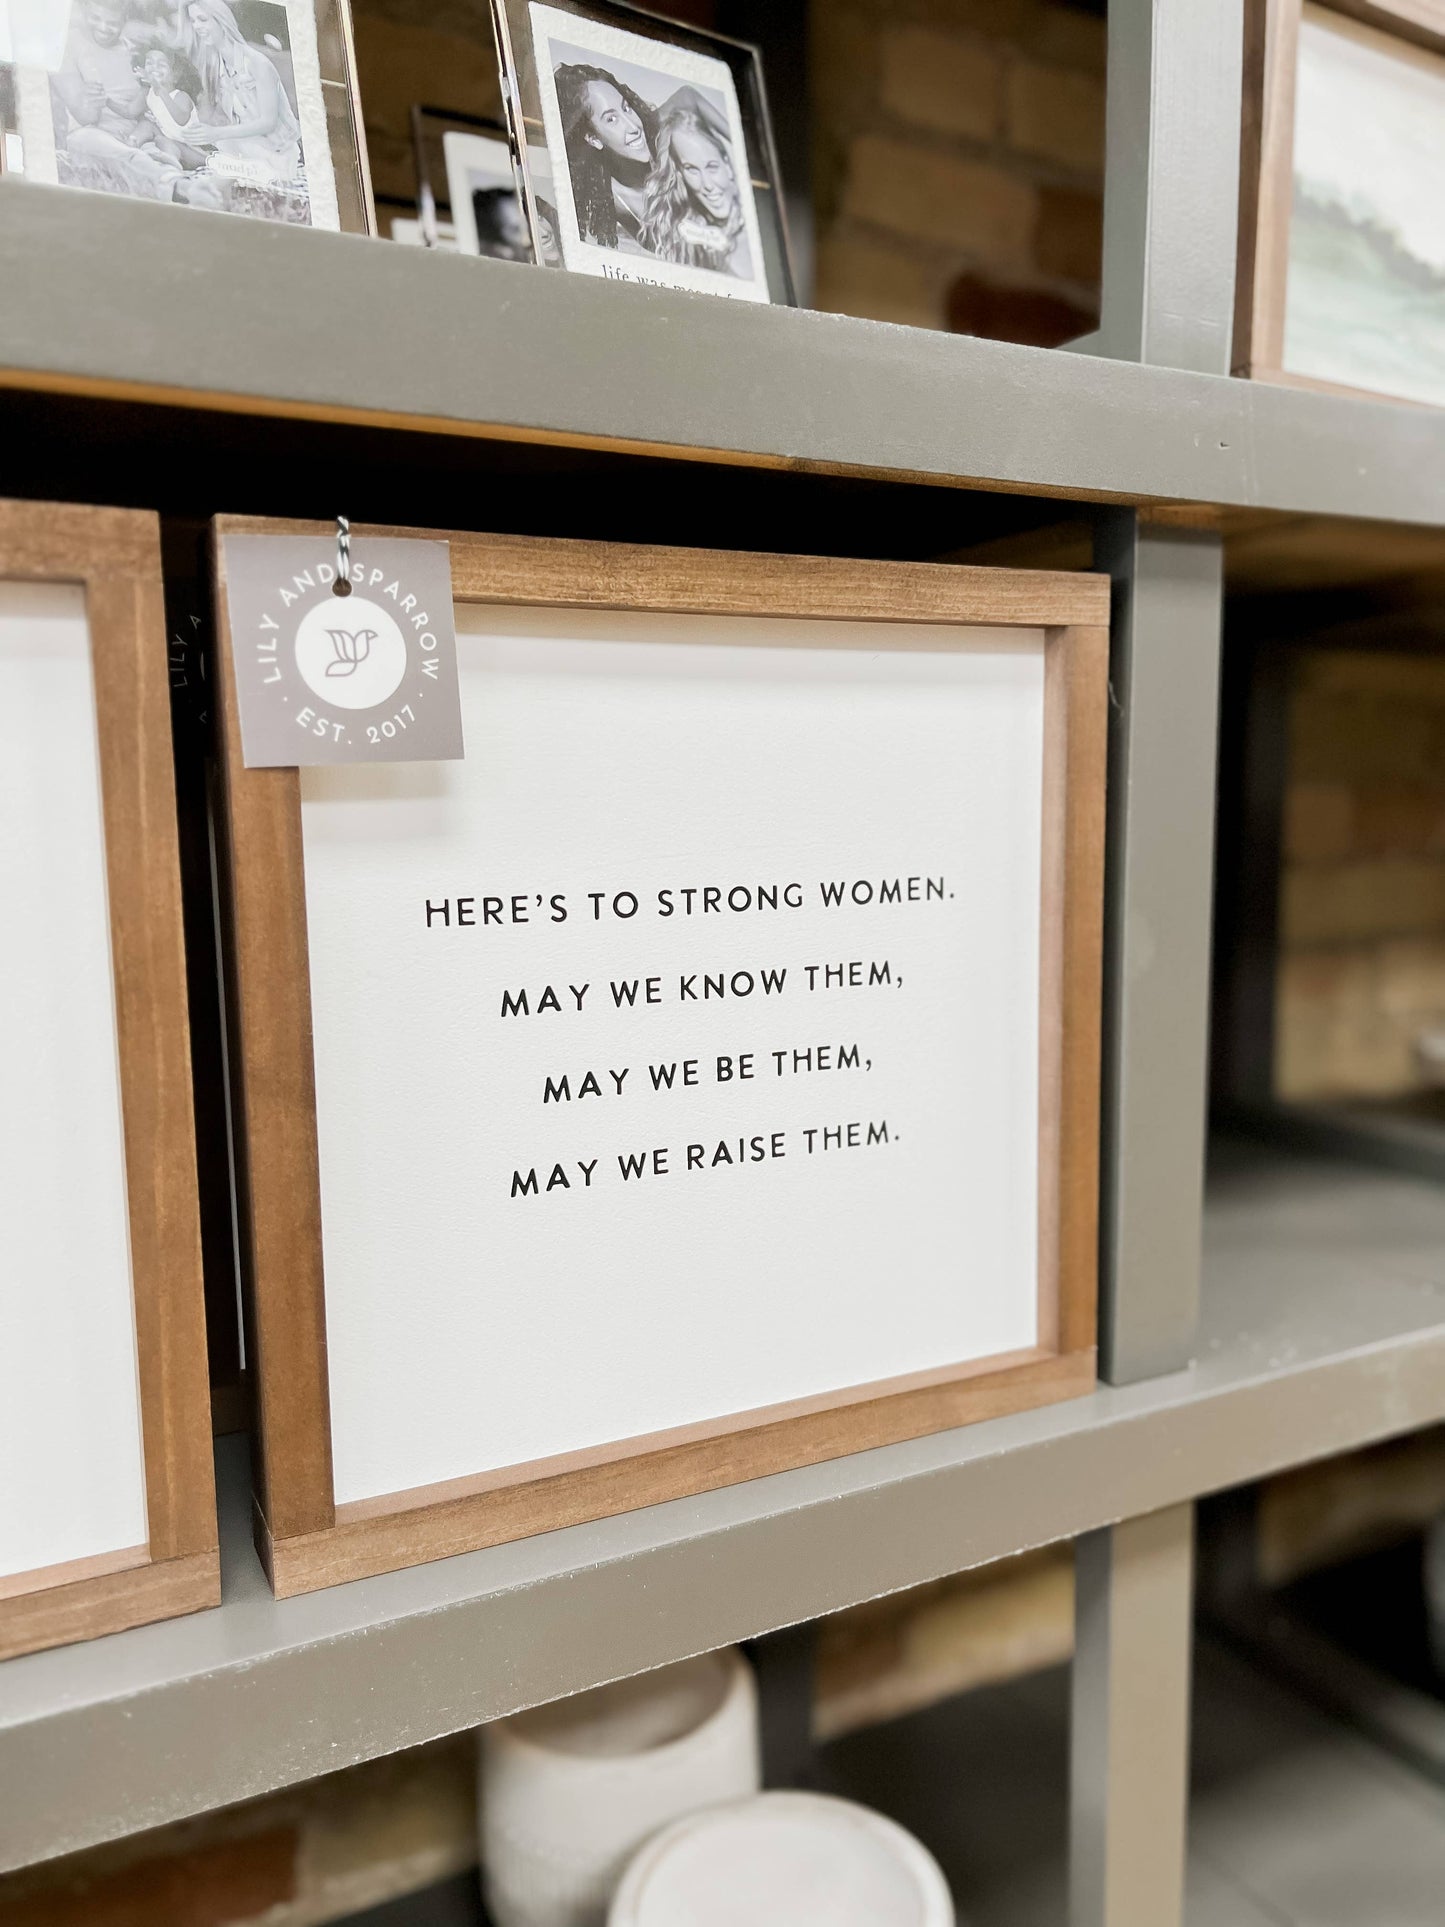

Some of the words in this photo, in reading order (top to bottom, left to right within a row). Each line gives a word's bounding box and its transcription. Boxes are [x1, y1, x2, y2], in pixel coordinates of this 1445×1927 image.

[601, 264, 629, 281] life
[257, 613, 282, 683] LILY
[279, 563, 334, 607] AND
[351, 563, 440, 680] SPARROW
[169, 633, 189, 688] LILY
[295, 706, 352, 745] EST.
[366, 704, 416, 744] 2017
[425, 894, 568, 928] HERE’S
[587, 891, 639, 921] TO
[657, 884, 803, 917] STRONG
[819, 876, 955, 908] WOMEN.
[500, 983, 590, 1018] MAY
[609, 976, 662, 1008] WE
[680, 968, 787, 1001] KNOW
[803, 960, 903, 991] THEM,
[543, 1068, 630, 1104] MAY
[648, 1059, 699, 1091] WE
[716, 1053, 755, 1083] BE
[771, 1043, 872, 1077] THEM,
[510, 1159, 599, 1198] MAY
[617, 1147, 669, 1182] WE
[686, 1132, 786, 1171] RAISE
[802, 1120, 900, 1155] THEM.
